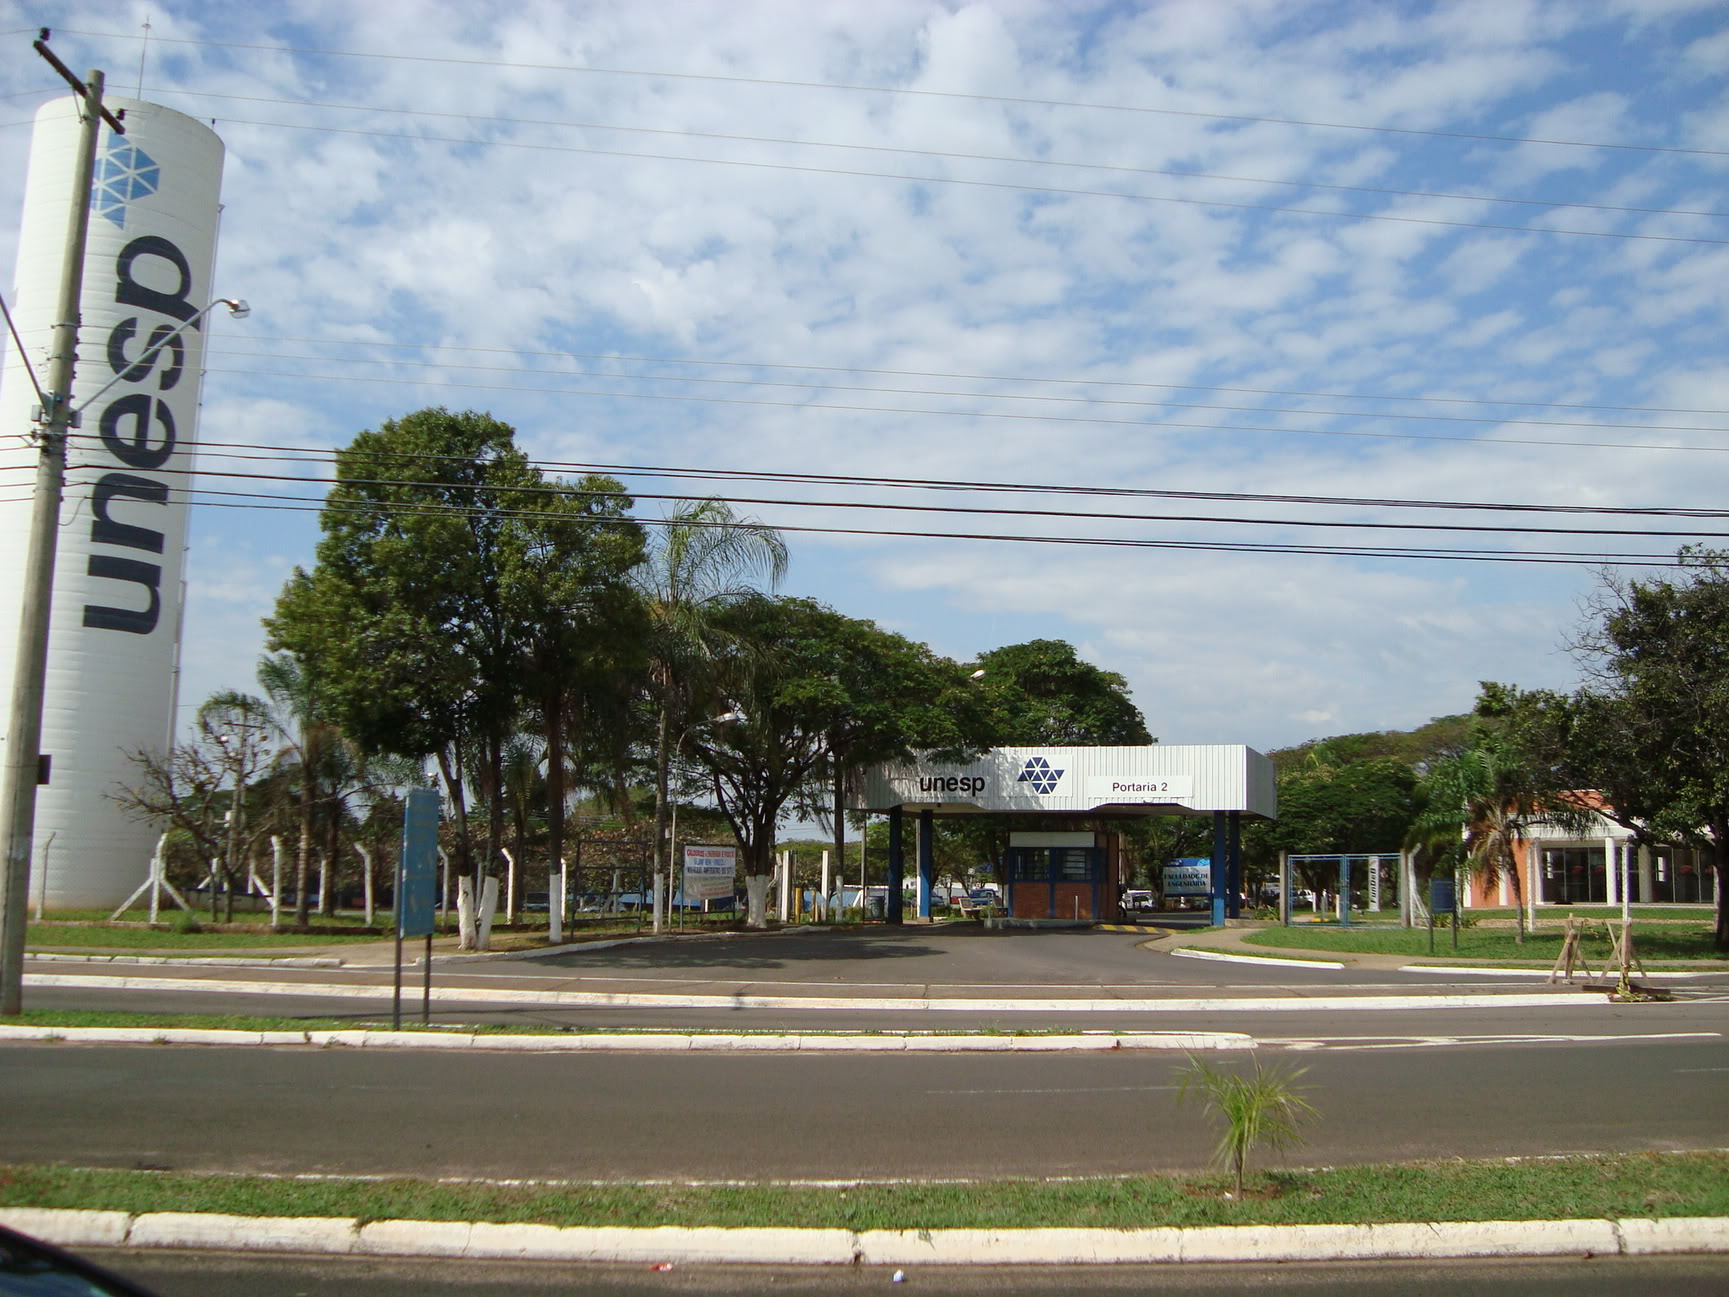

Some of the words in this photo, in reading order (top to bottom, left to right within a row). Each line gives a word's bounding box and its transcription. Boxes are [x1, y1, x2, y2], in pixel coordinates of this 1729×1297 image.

[82, 235, 201, 635] unesp
[920, 776, 985, 797] unesp
[1112, 782, 1157, 792] Portaria
[1161, 782, 1168, 792] 2
